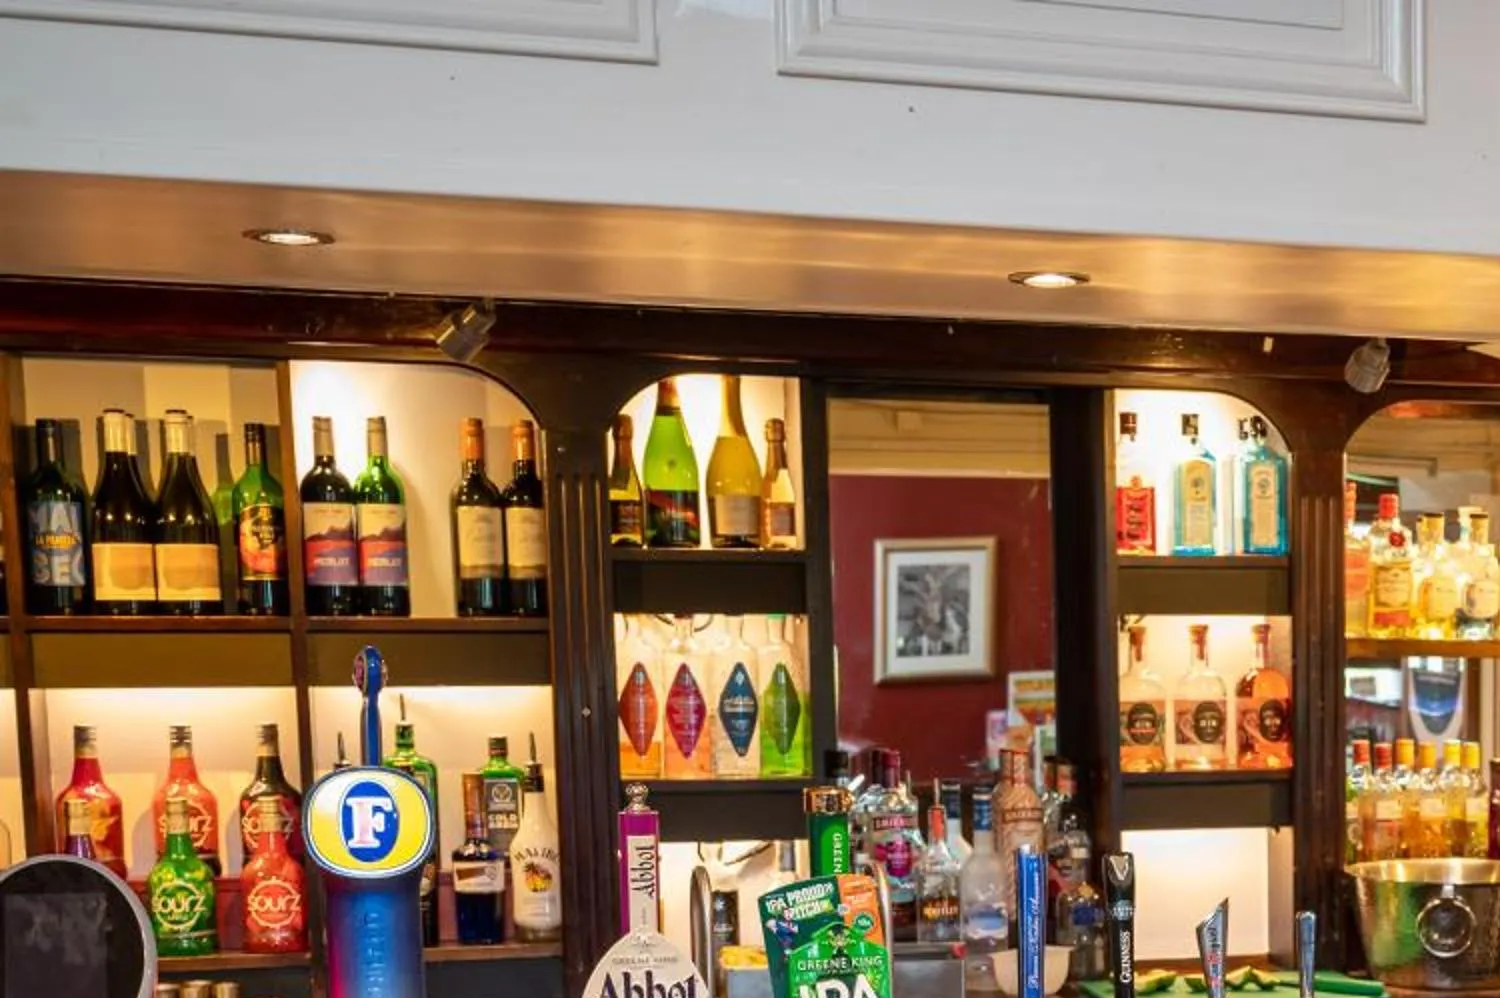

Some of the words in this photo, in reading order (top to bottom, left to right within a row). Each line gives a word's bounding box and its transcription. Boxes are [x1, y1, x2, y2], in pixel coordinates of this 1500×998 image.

[346, 797, 393, 848] F
[630, 845, 655, 899] Abbot
[797, 958, 847, 971] GREENE
[852, 955, 883, 968] KING
[1120, 931, 1132, 983] GUINNESS
